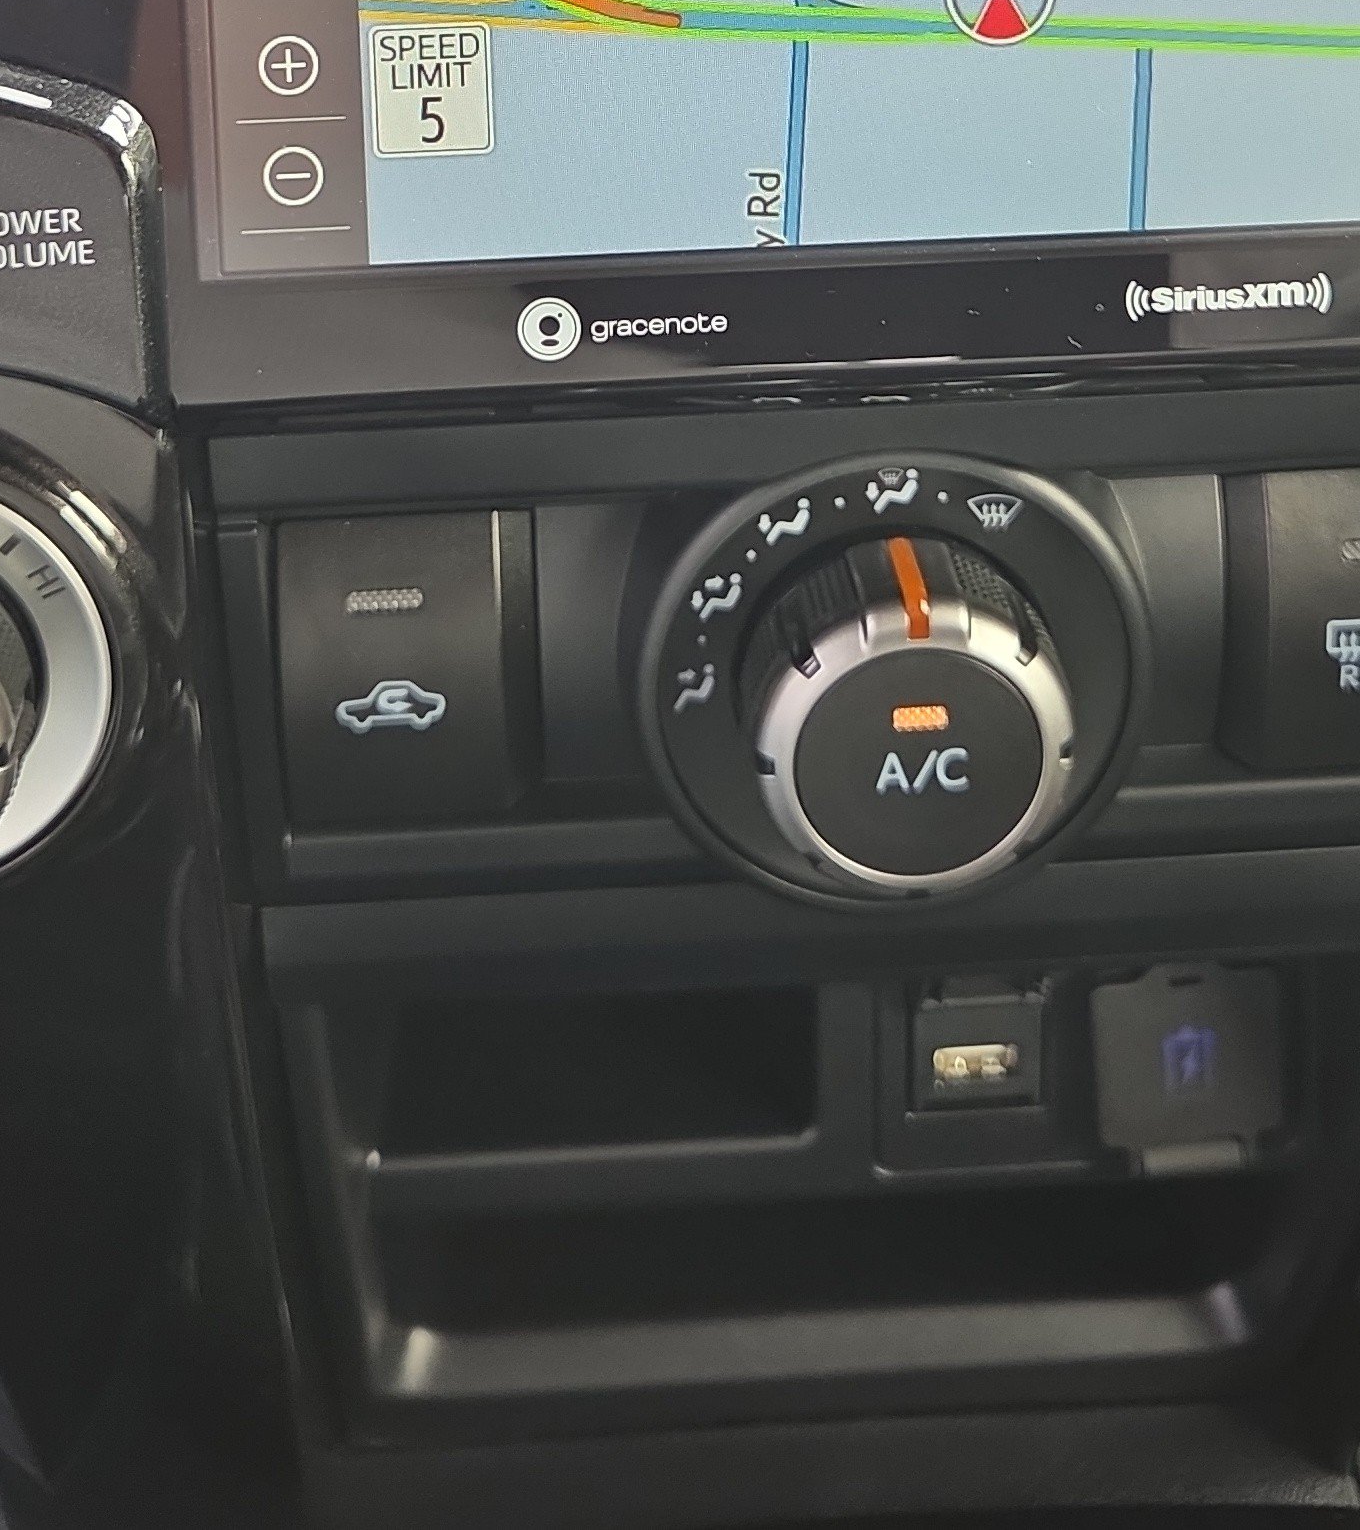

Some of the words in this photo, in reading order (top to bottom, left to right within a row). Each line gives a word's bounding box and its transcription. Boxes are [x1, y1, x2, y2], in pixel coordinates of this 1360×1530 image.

[378, 34, 481, 62] SPEED
[390, 61, 472, 91] LIMIT
[419, 96, 445, 144] 5
[746, 172, 781, 217] Rd
[590, 312, 728, 344] gracenote
[25, 562, 67, 601] HI
[874, 746, 971, 795] A/C
